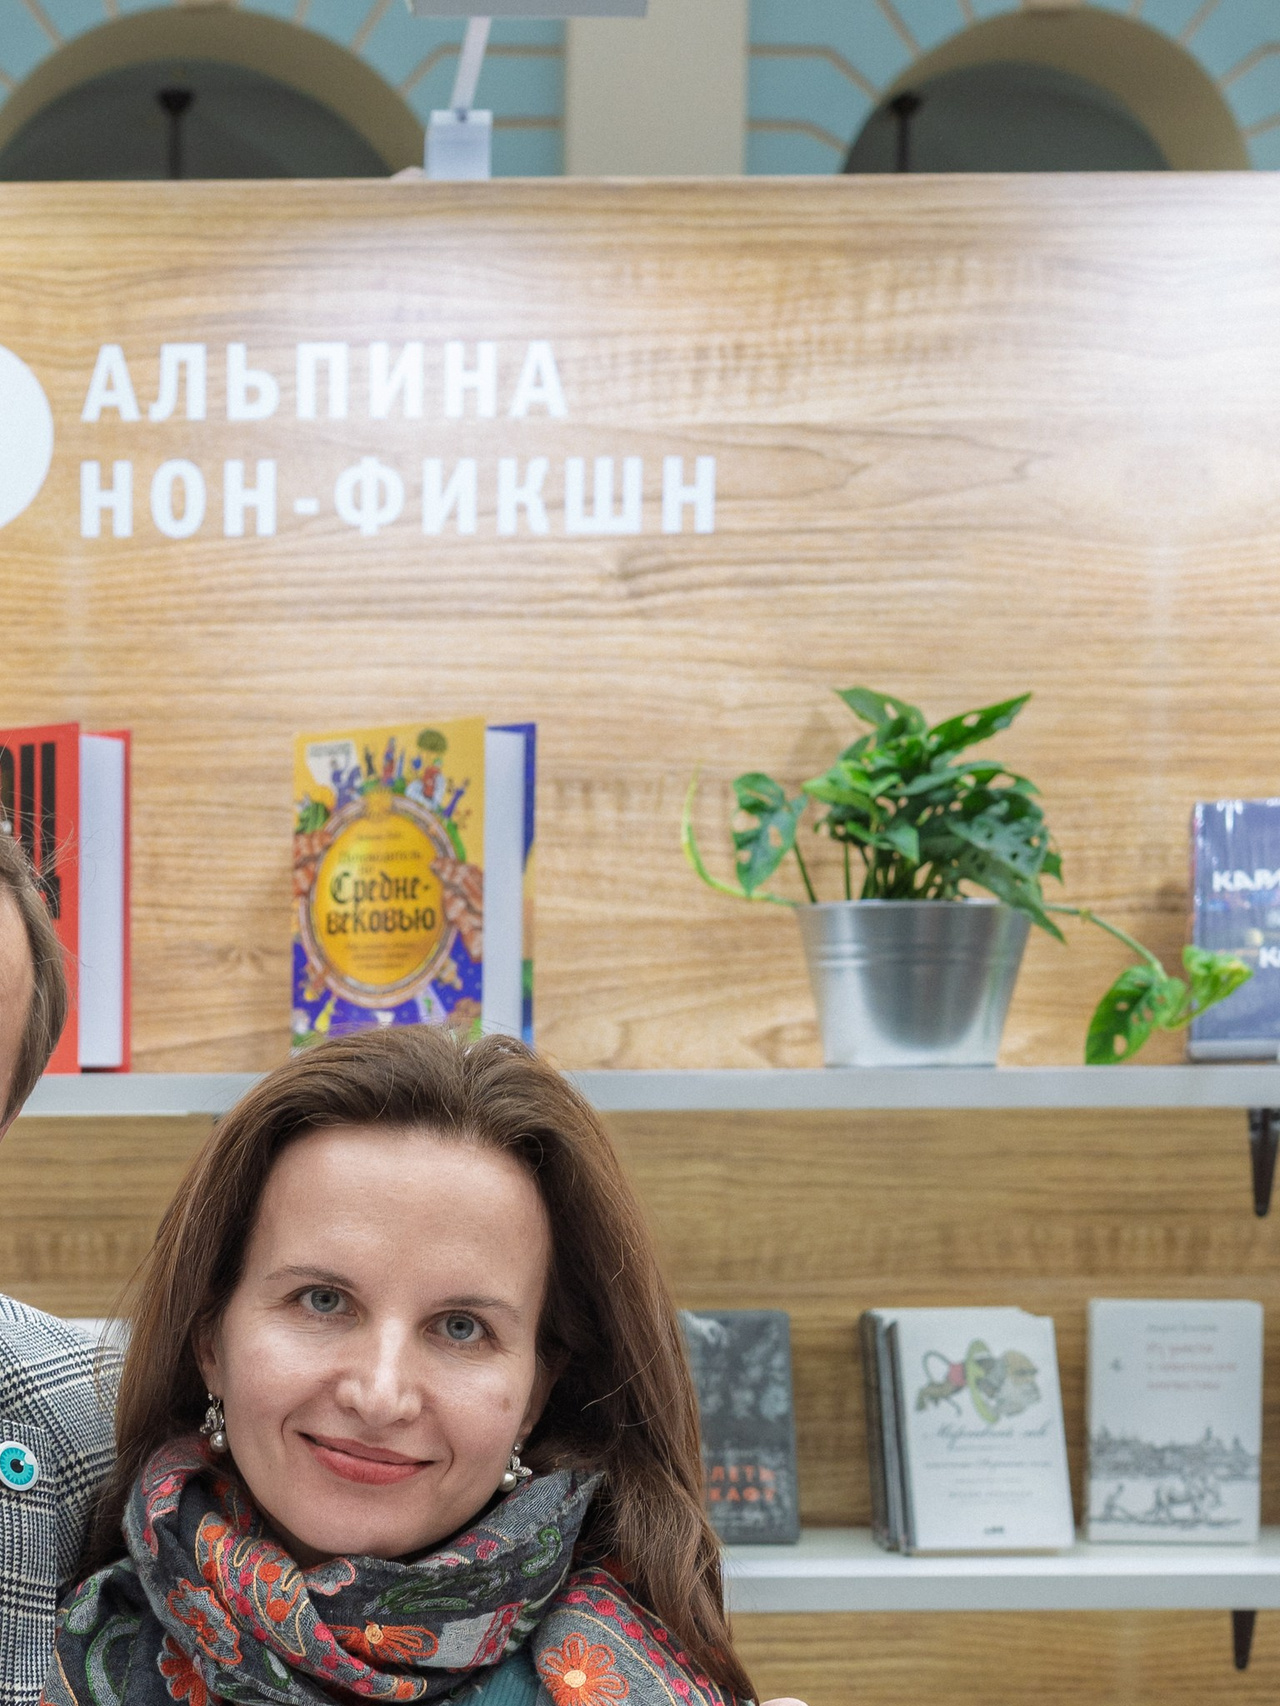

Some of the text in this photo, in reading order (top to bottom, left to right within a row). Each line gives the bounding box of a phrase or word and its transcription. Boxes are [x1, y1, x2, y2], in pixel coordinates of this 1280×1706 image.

[80, 340, 569, 422] АЛЬПИНА
[79, 456, 717, 539] НОН-ФИКШН
[331, 871, 430, 905] Средне-
